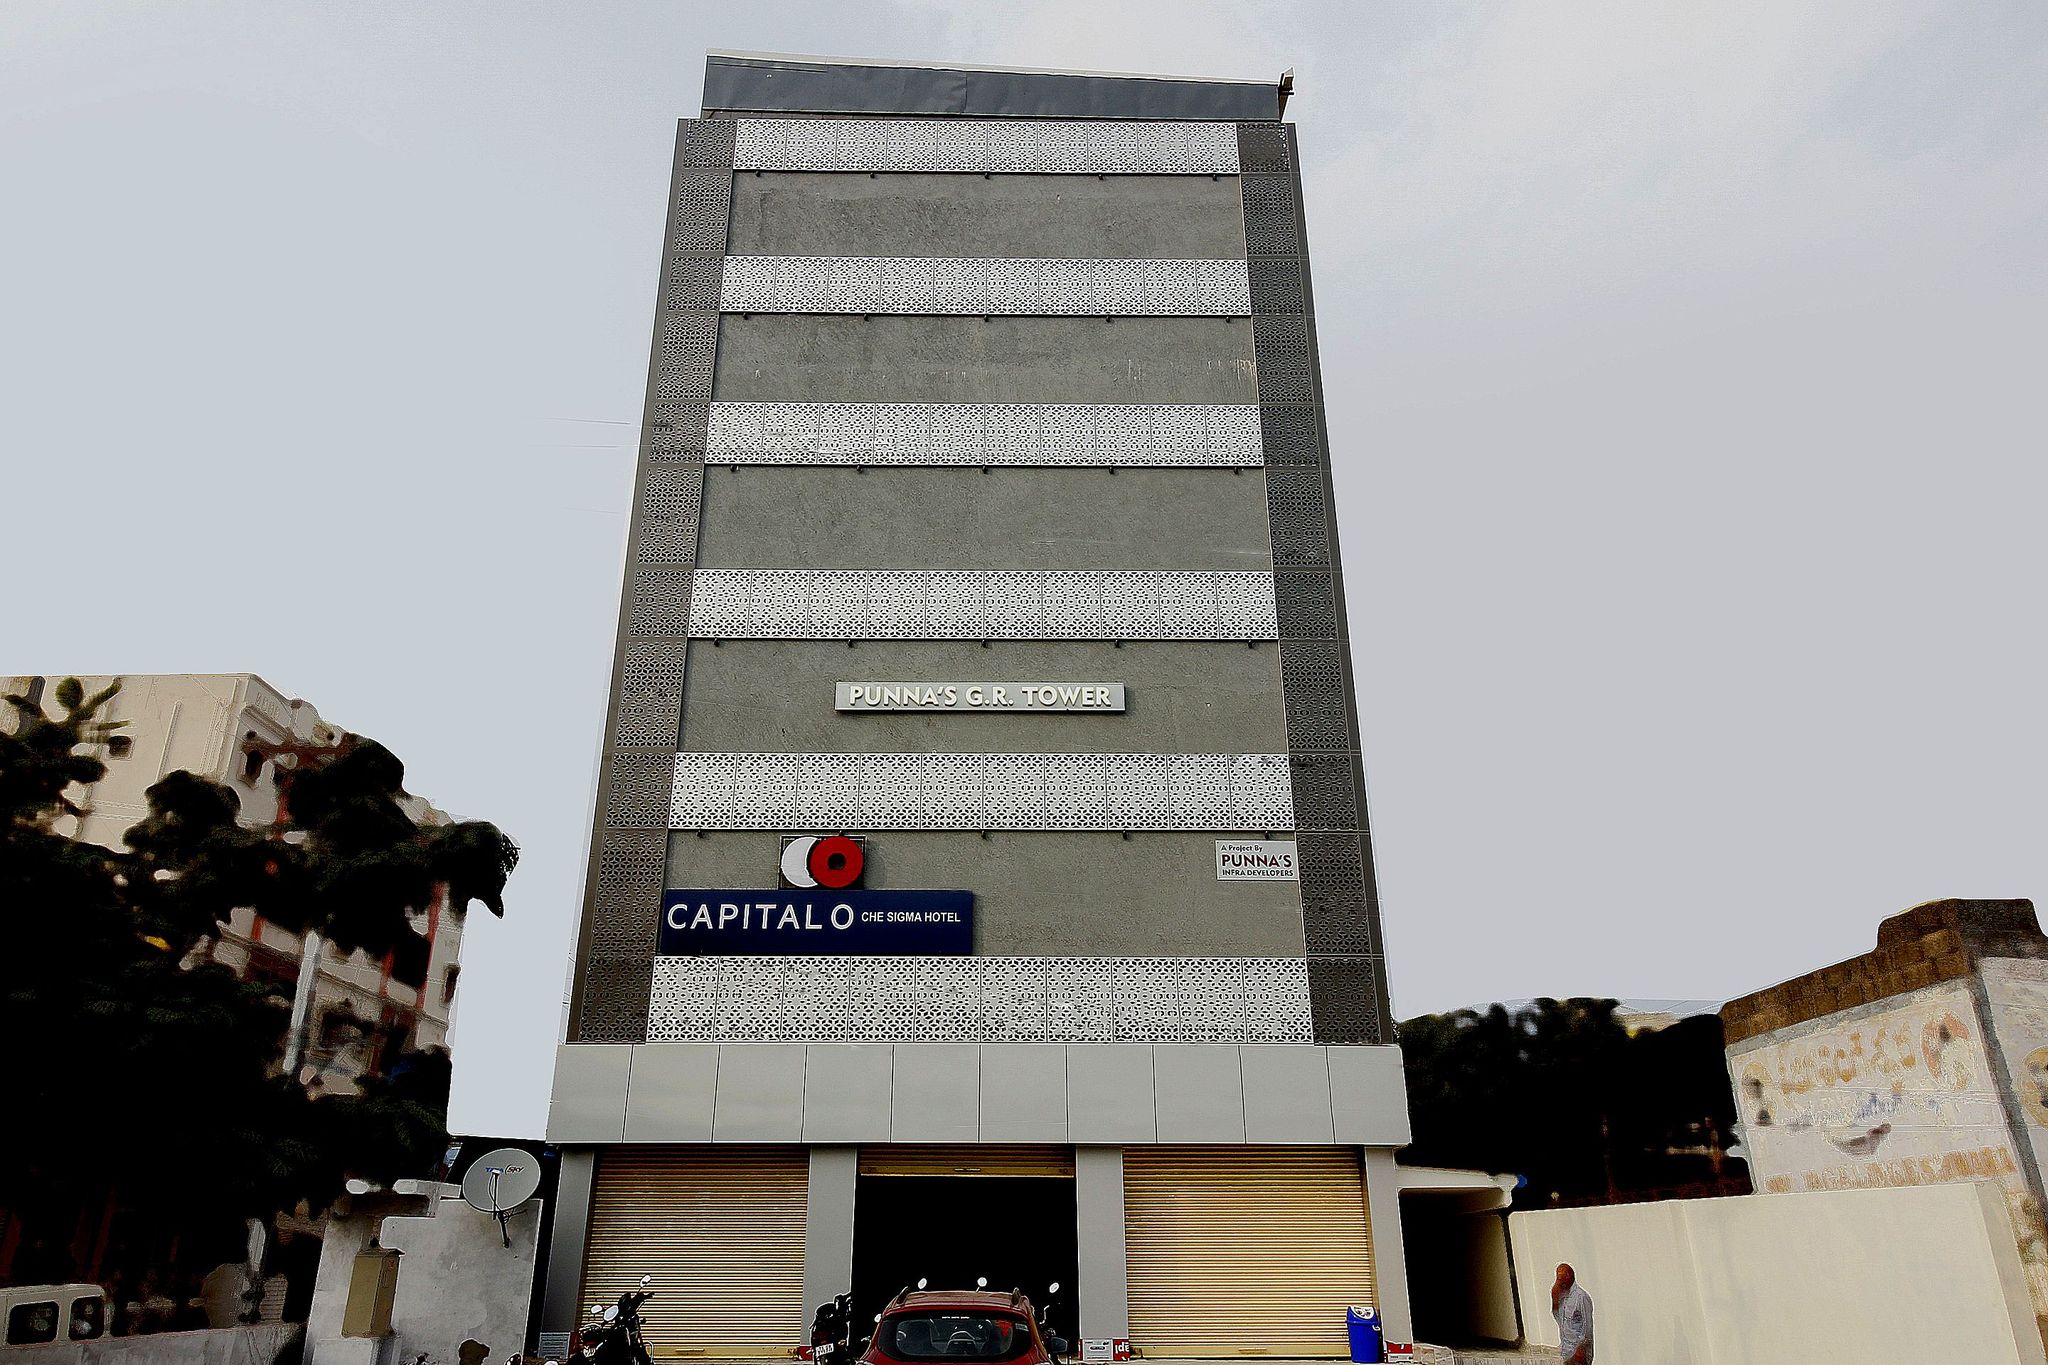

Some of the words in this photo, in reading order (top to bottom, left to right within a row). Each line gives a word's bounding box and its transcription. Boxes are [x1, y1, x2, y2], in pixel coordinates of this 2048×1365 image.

[850, 686, 957, 706] PUNNA'S
[965, 686, 1014, 706] G.R.
[1022, 686, 1111, 706] TOWER
[1221, 854, 1292, 868] PUNNA'S
[1246, 869, 1294, 877] DEVELOPERS
[667, 904, 822, 930] CAPITAL
[831, 904, 854, 930] O
[861, 911, 885, 922] CHE
[886, 911, 922, 923] SIGMA
[924, 912, 961, 923] HOTEL
